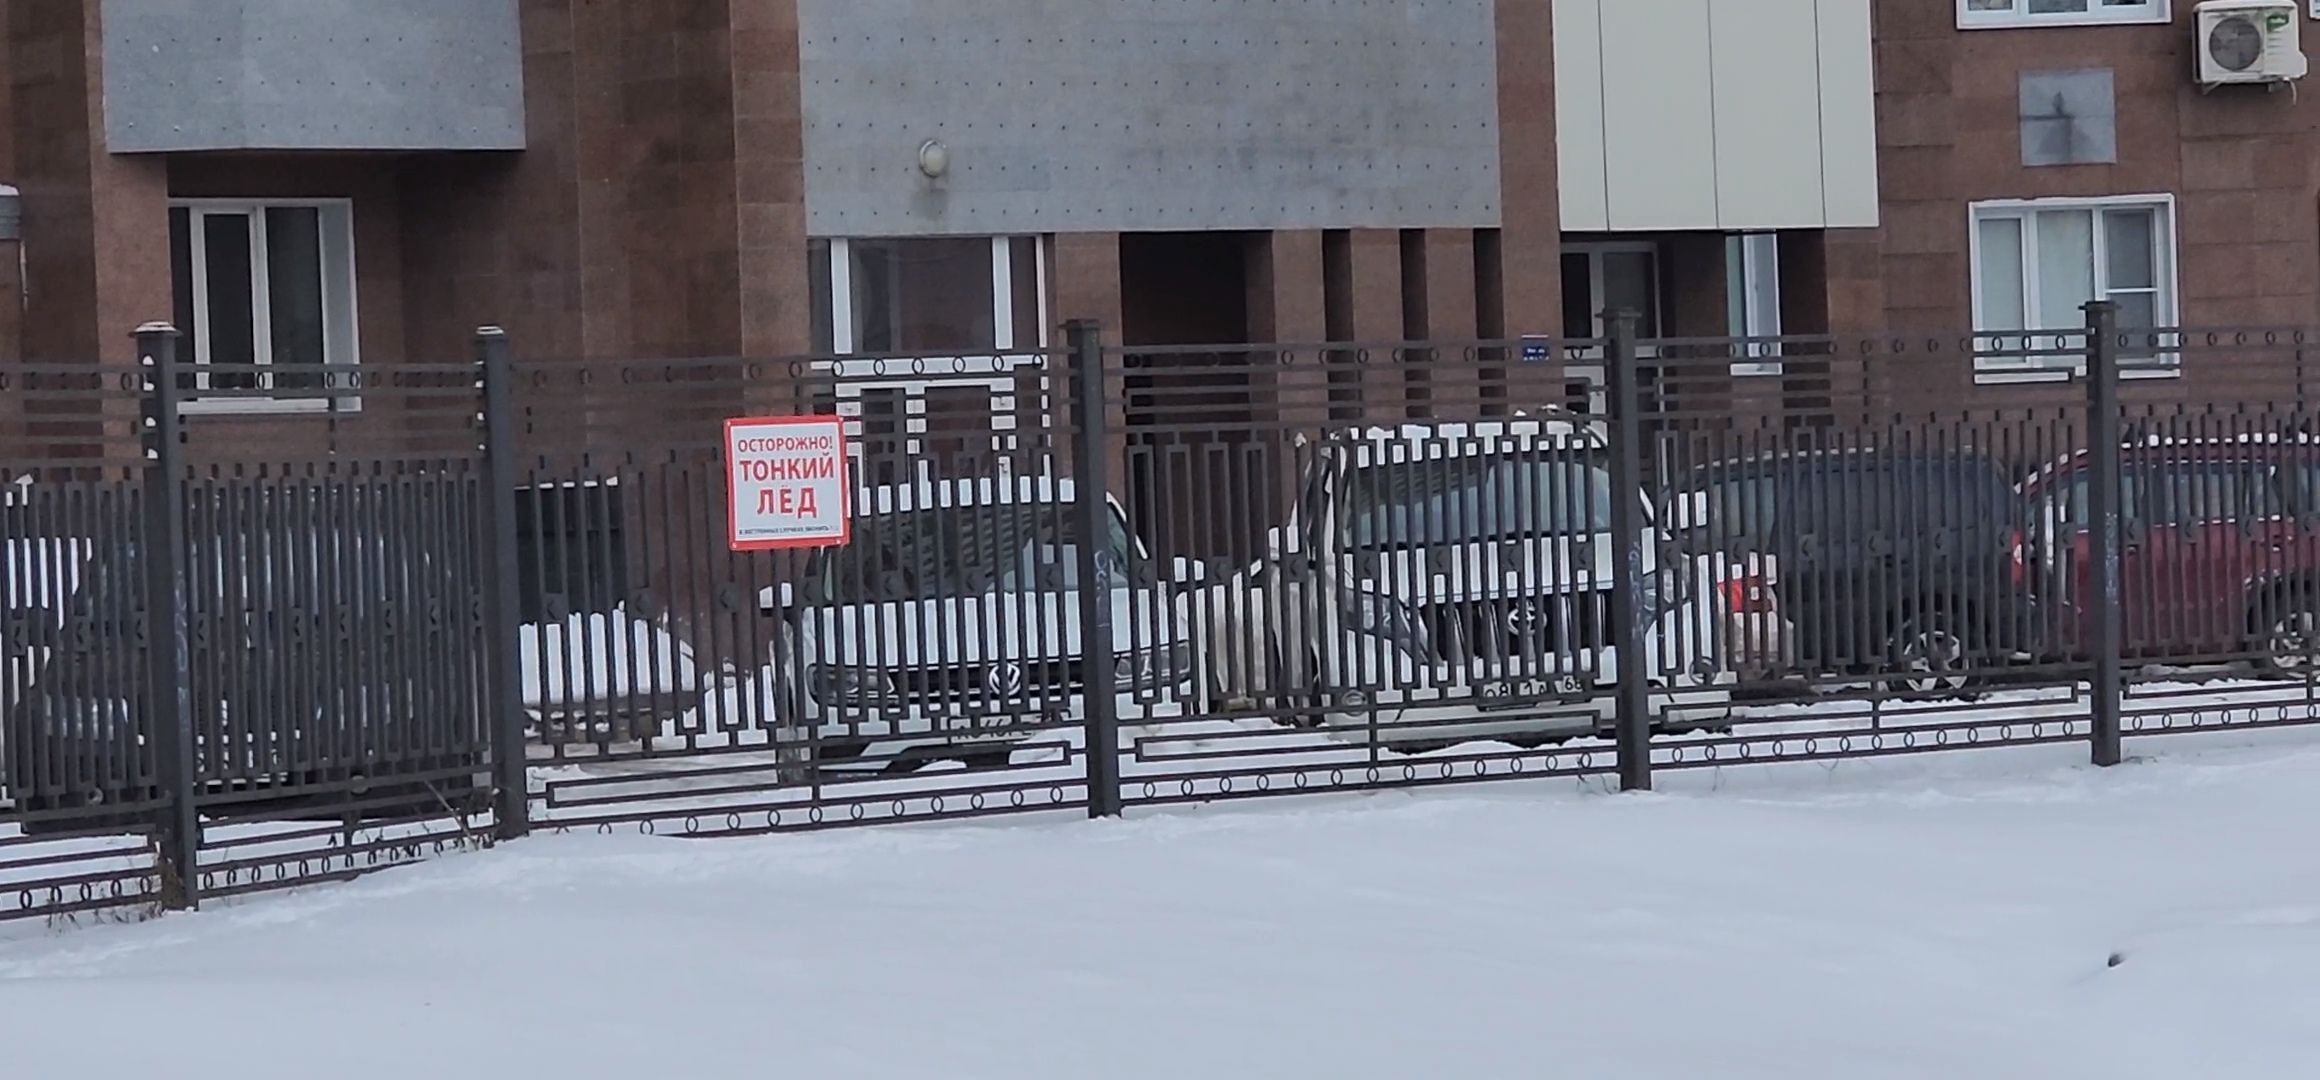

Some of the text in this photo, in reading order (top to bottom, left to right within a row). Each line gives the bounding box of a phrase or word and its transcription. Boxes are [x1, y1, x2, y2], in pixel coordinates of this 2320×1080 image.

[738, 436, 833, 453] ОСТОРОЖНО!
[739, 452, 834, 482] ТОНКИЙ
[757, 484, 817, 519] ЛЁД
